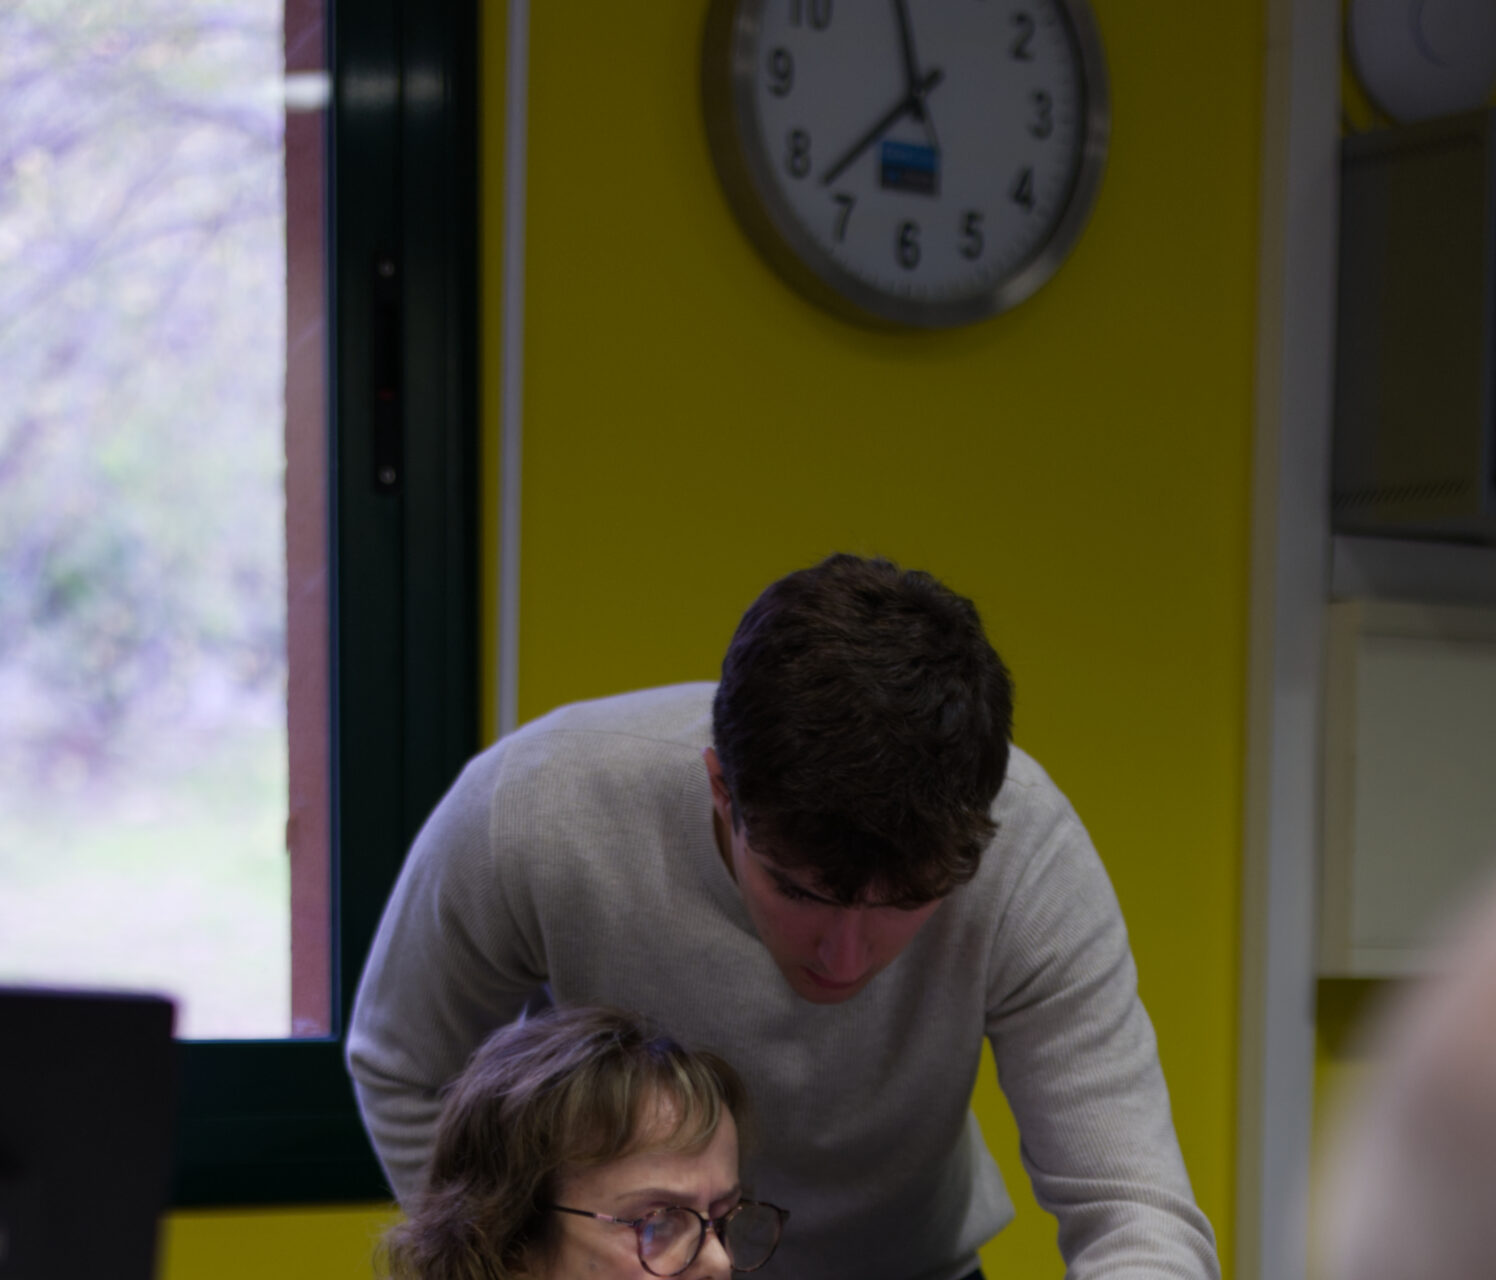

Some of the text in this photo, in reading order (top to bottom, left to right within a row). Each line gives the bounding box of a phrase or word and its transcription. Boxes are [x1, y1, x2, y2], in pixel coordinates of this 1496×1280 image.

[789, 0, 833, 31] 10
[1010, 11, 1035, 61] 2
[767, 47, 794, 98] 9
[1030, 90, 1053, 140] 3
[785, 129, 811, 179] 8
[1010, 167, 1036, 213] 4
[833, 193, 855, 242] 7
[960, 211, 983, 261] 5
[896, 221, 920, 270] 6
